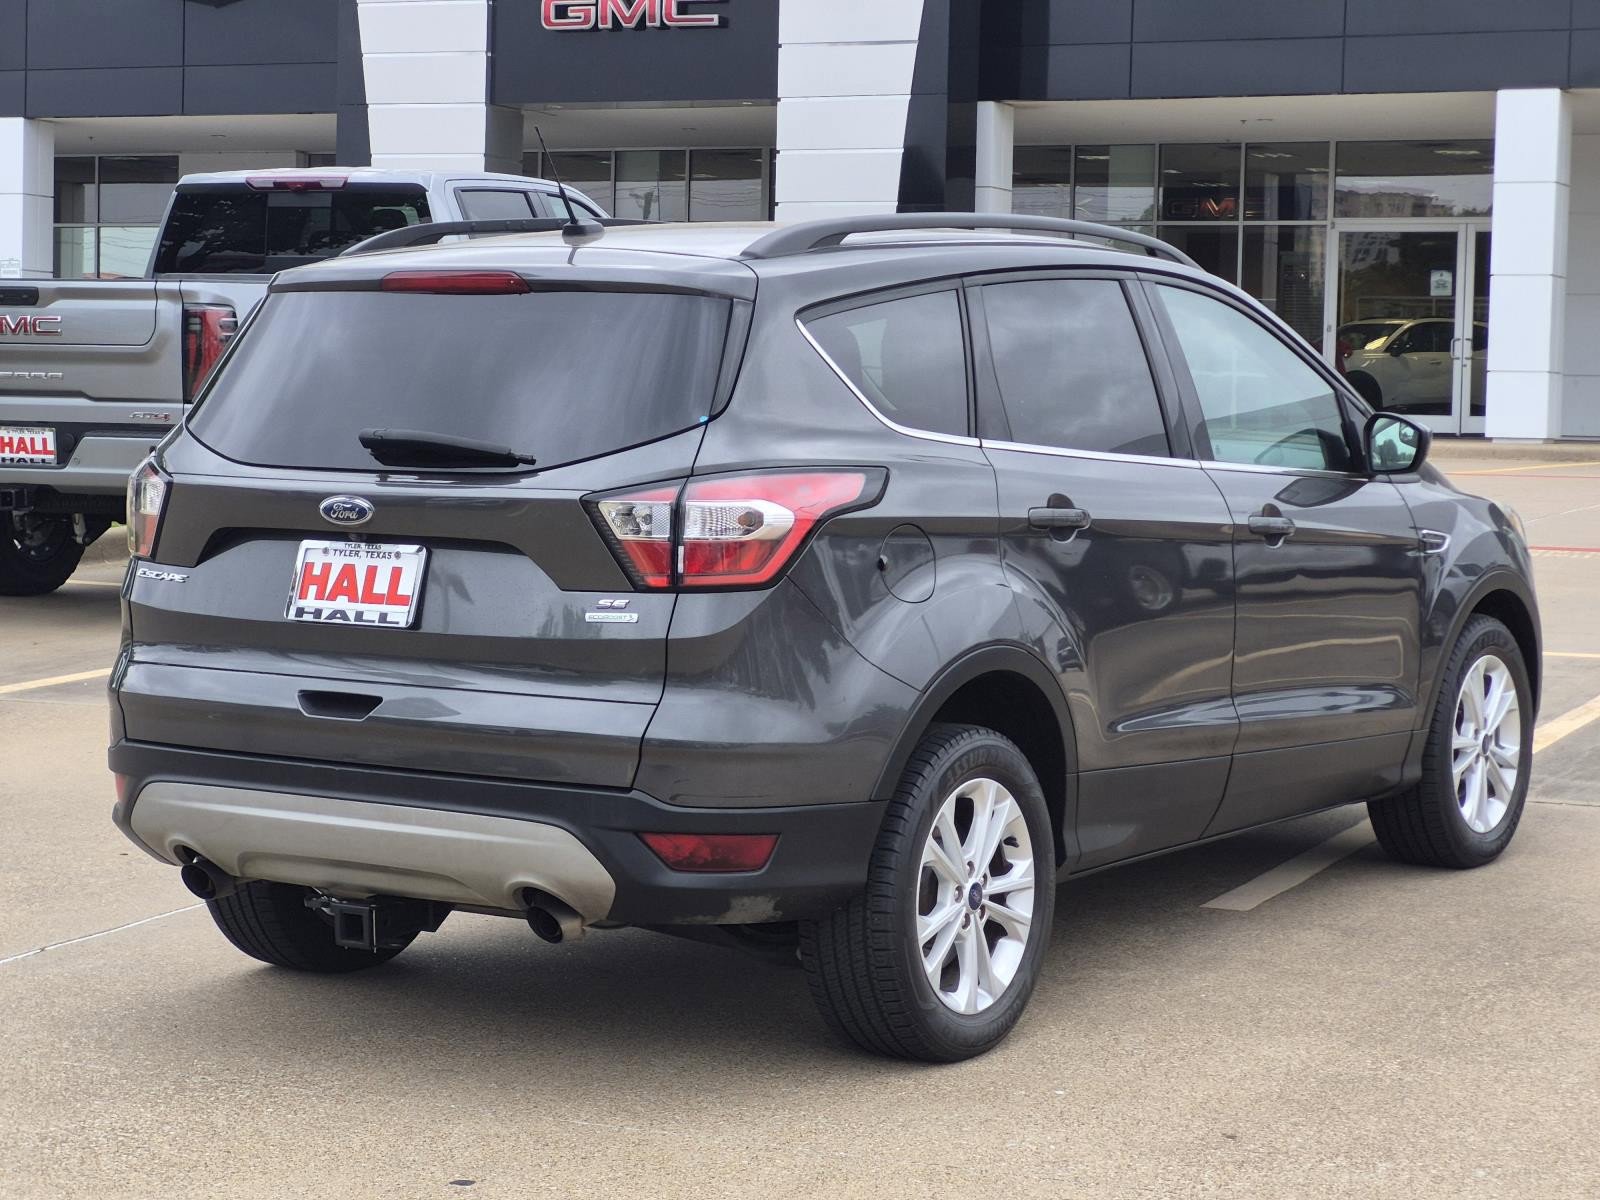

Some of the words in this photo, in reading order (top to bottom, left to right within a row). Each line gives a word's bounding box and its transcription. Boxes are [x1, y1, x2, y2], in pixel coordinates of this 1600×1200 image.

[541, 0, 720, 30] GMC
[0, 436, 55, 455] HALL
[330, 503, 359, 519] Ford
[333, 549, 362, 558] TYLER,
[365, 551, 392, 559] TEXAS
[137, 568, 190, 583] ESCAPE
[298, 561, 411, 606] HALL
[596, 599, 630, 609] SE
[294, 606, 400, 625] HALL
